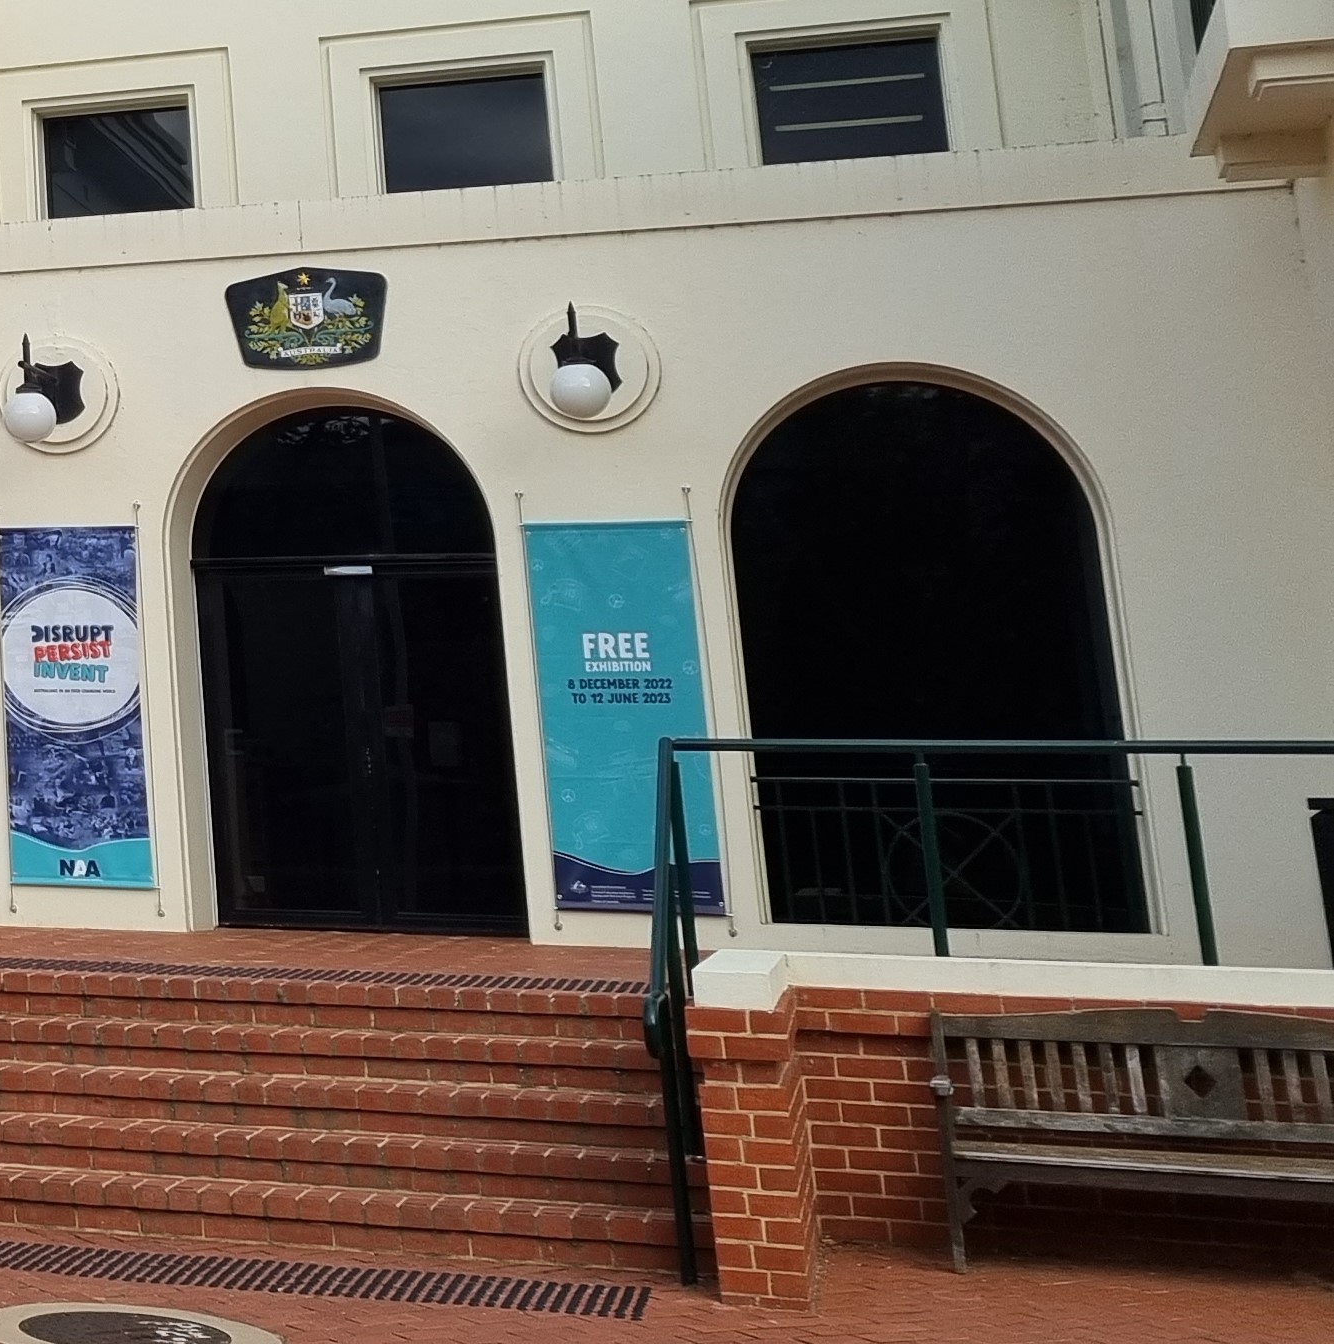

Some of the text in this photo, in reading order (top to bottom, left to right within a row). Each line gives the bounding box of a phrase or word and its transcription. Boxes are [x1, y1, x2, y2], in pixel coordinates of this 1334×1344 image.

[283, 346, 338, 356] AUSTRALIA
[31, 624, 114, 644] DISRUPT
[34, 640, 112, 663] PERSIST
[582, 632, 650, 659] FREE
[33, 660, 109, 683] INVENT
[585, 661, 652, 672] EXHIBITION
[567, 678, 673, 690] 8 DECEMBER 2022
[571, 692, 671, 704] TO 12 JUNE 2023
[59, 859, 101, 878] NAA
